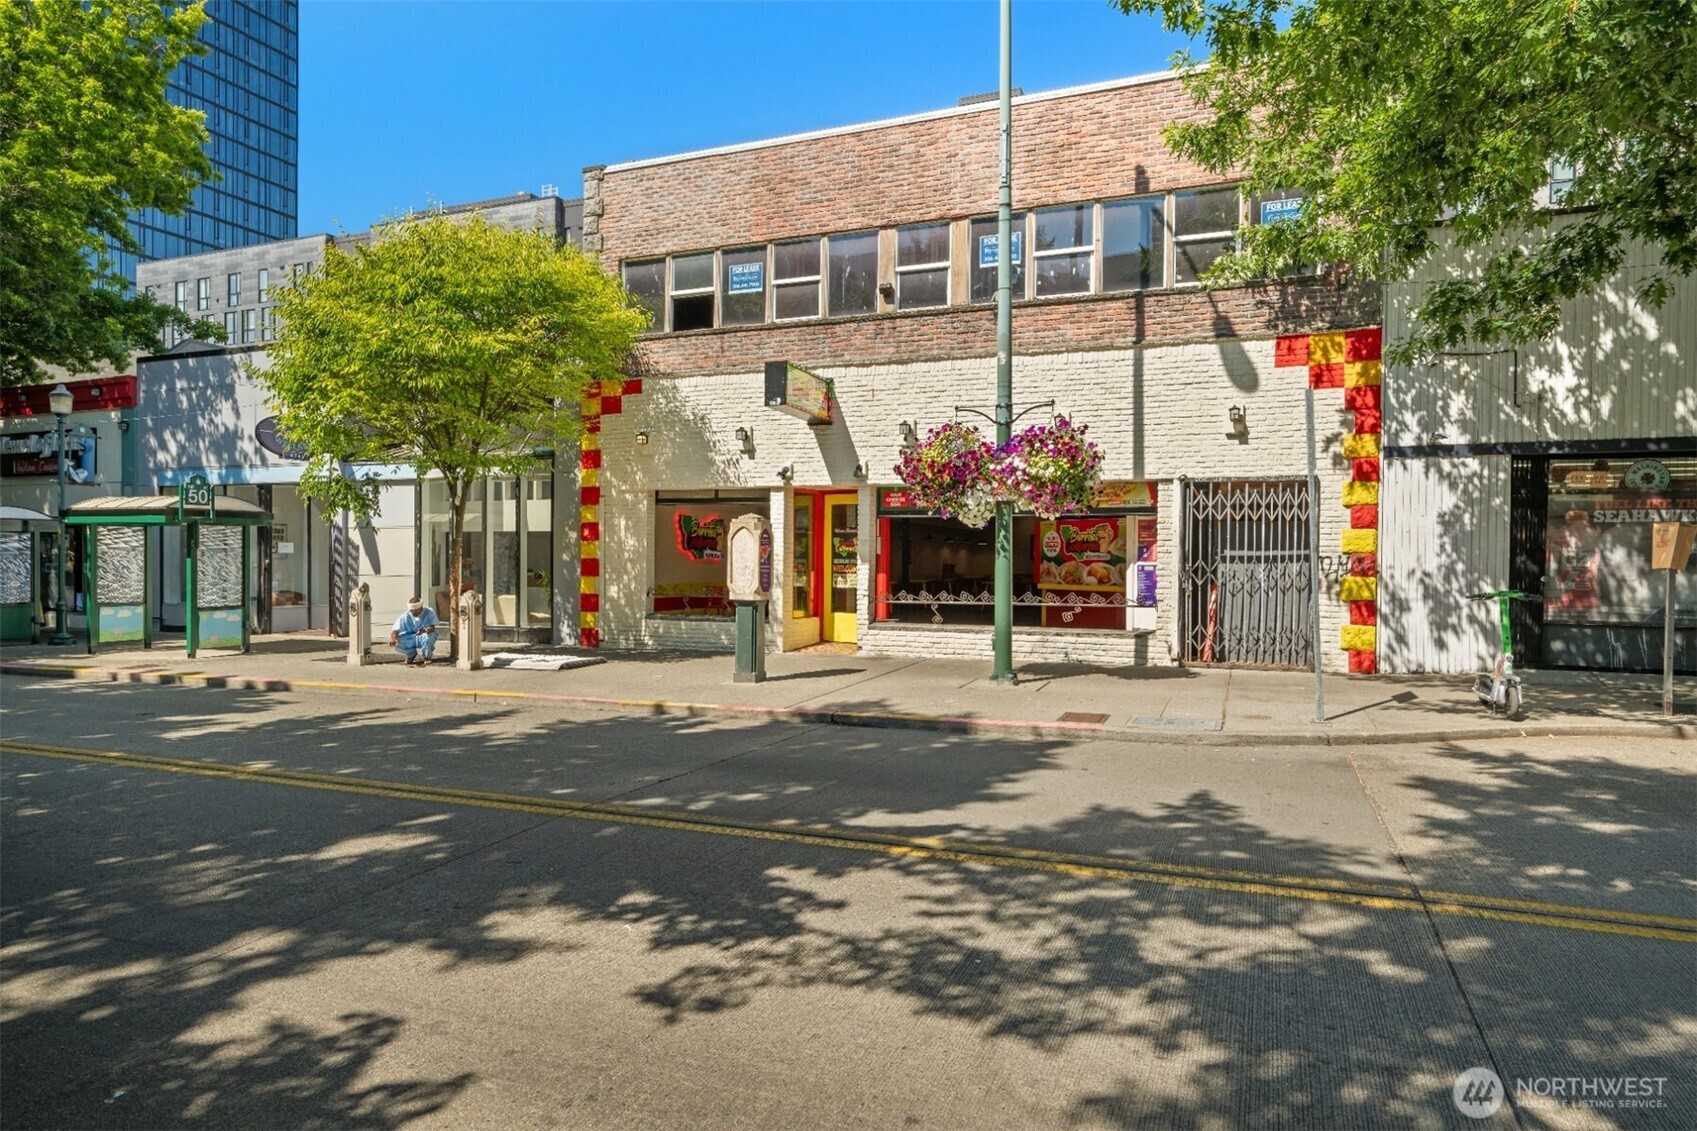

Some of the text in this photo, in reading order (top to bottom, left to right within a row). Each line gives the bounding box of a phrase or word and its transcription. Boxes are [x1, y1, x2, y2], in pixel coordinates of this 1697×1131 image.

[1266, 202, 1281, 211] FOR
[983, 236, 997, 244] FOR
[732, 266, 744, 274] FOR
[188, 489, 208, 504] 50
[1594, 498, 1697, 509] FUEL LIKE TH
[1593, 509, 1697, 523] SEAHAWK
